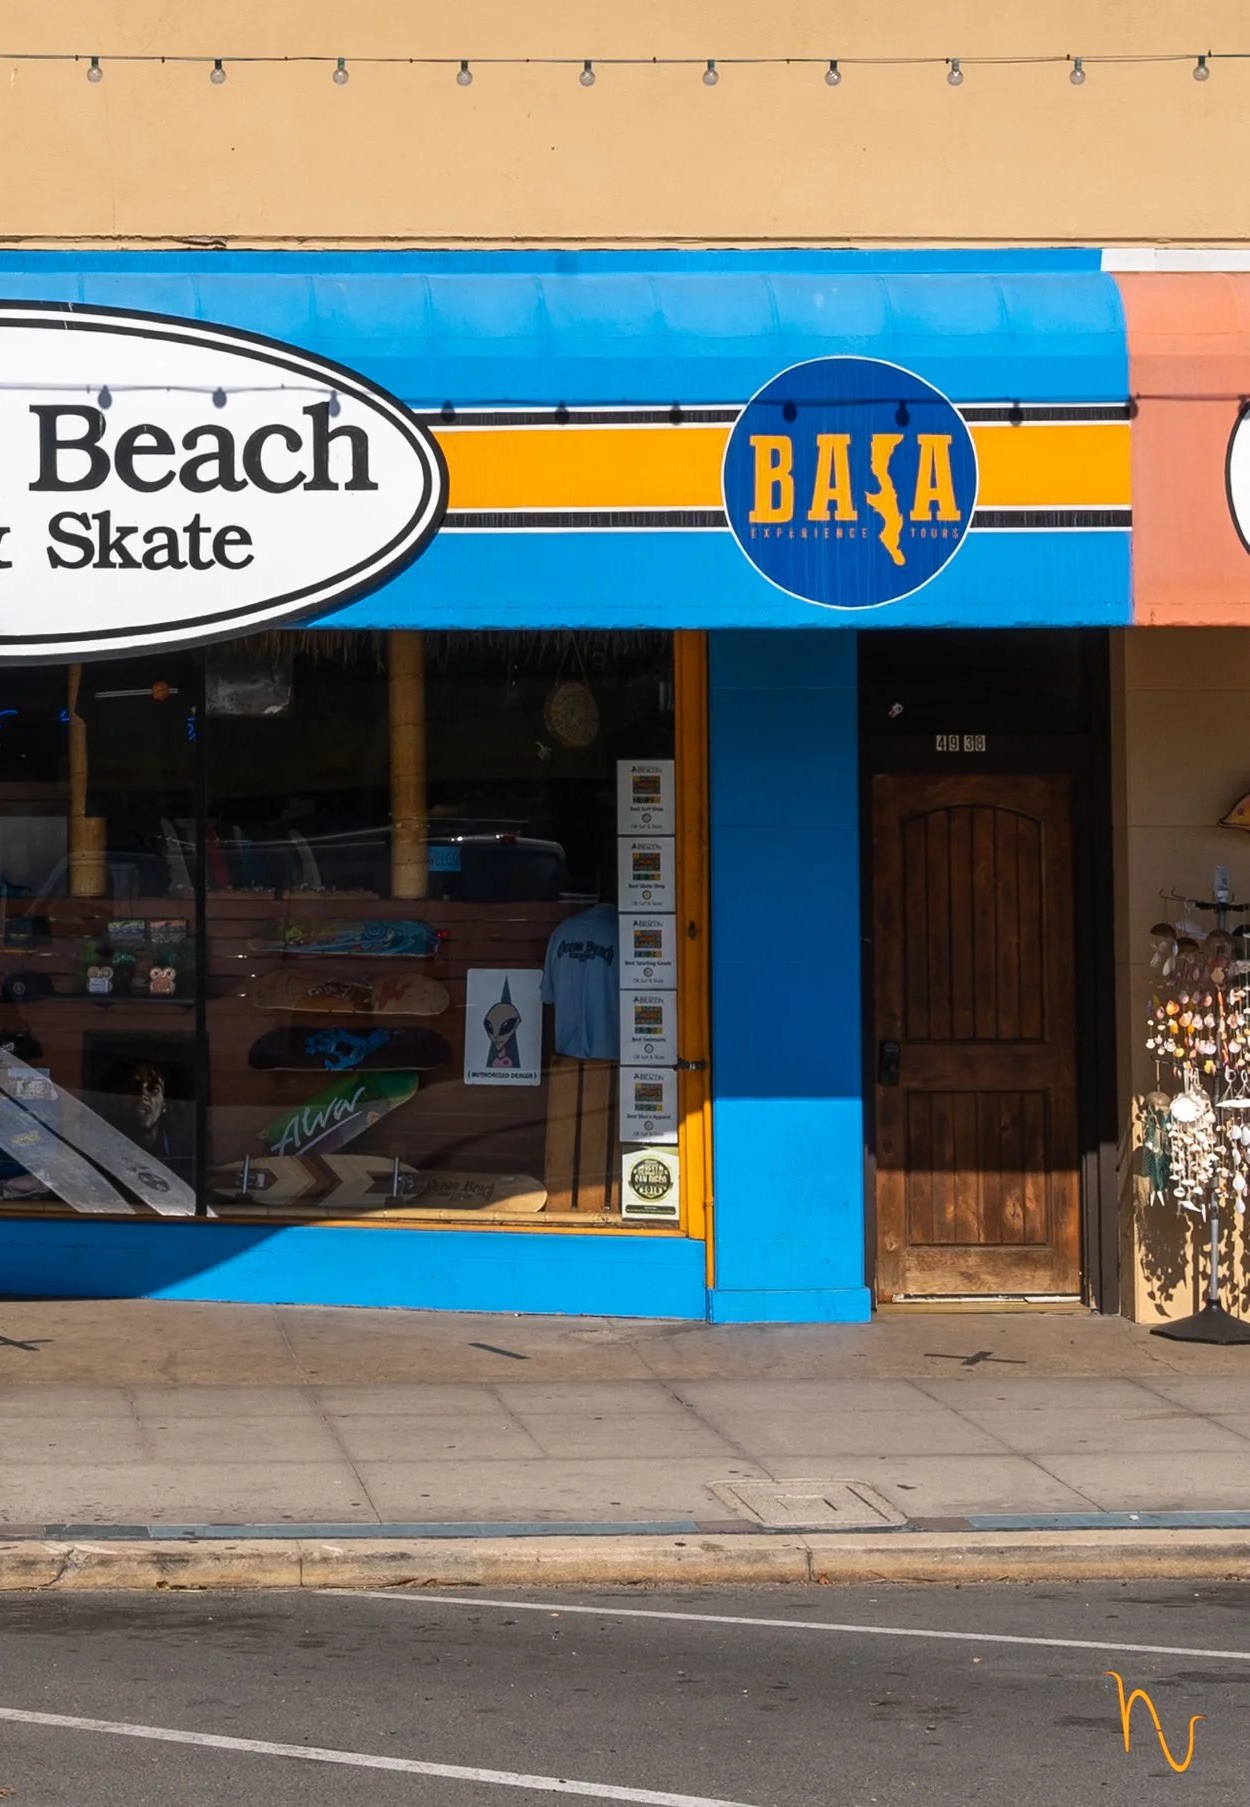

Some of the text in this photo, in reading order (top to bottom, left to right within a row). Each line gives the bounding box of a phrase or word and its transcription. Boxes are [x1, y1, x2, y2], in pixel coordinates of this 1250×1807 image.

[28, 401, 379, 493] Beach
[46, 509, 255, 570] Skate
[751, 527, 960, 540] EXPERIENCE TOURS
[936, 735, 986, 751] 4938
